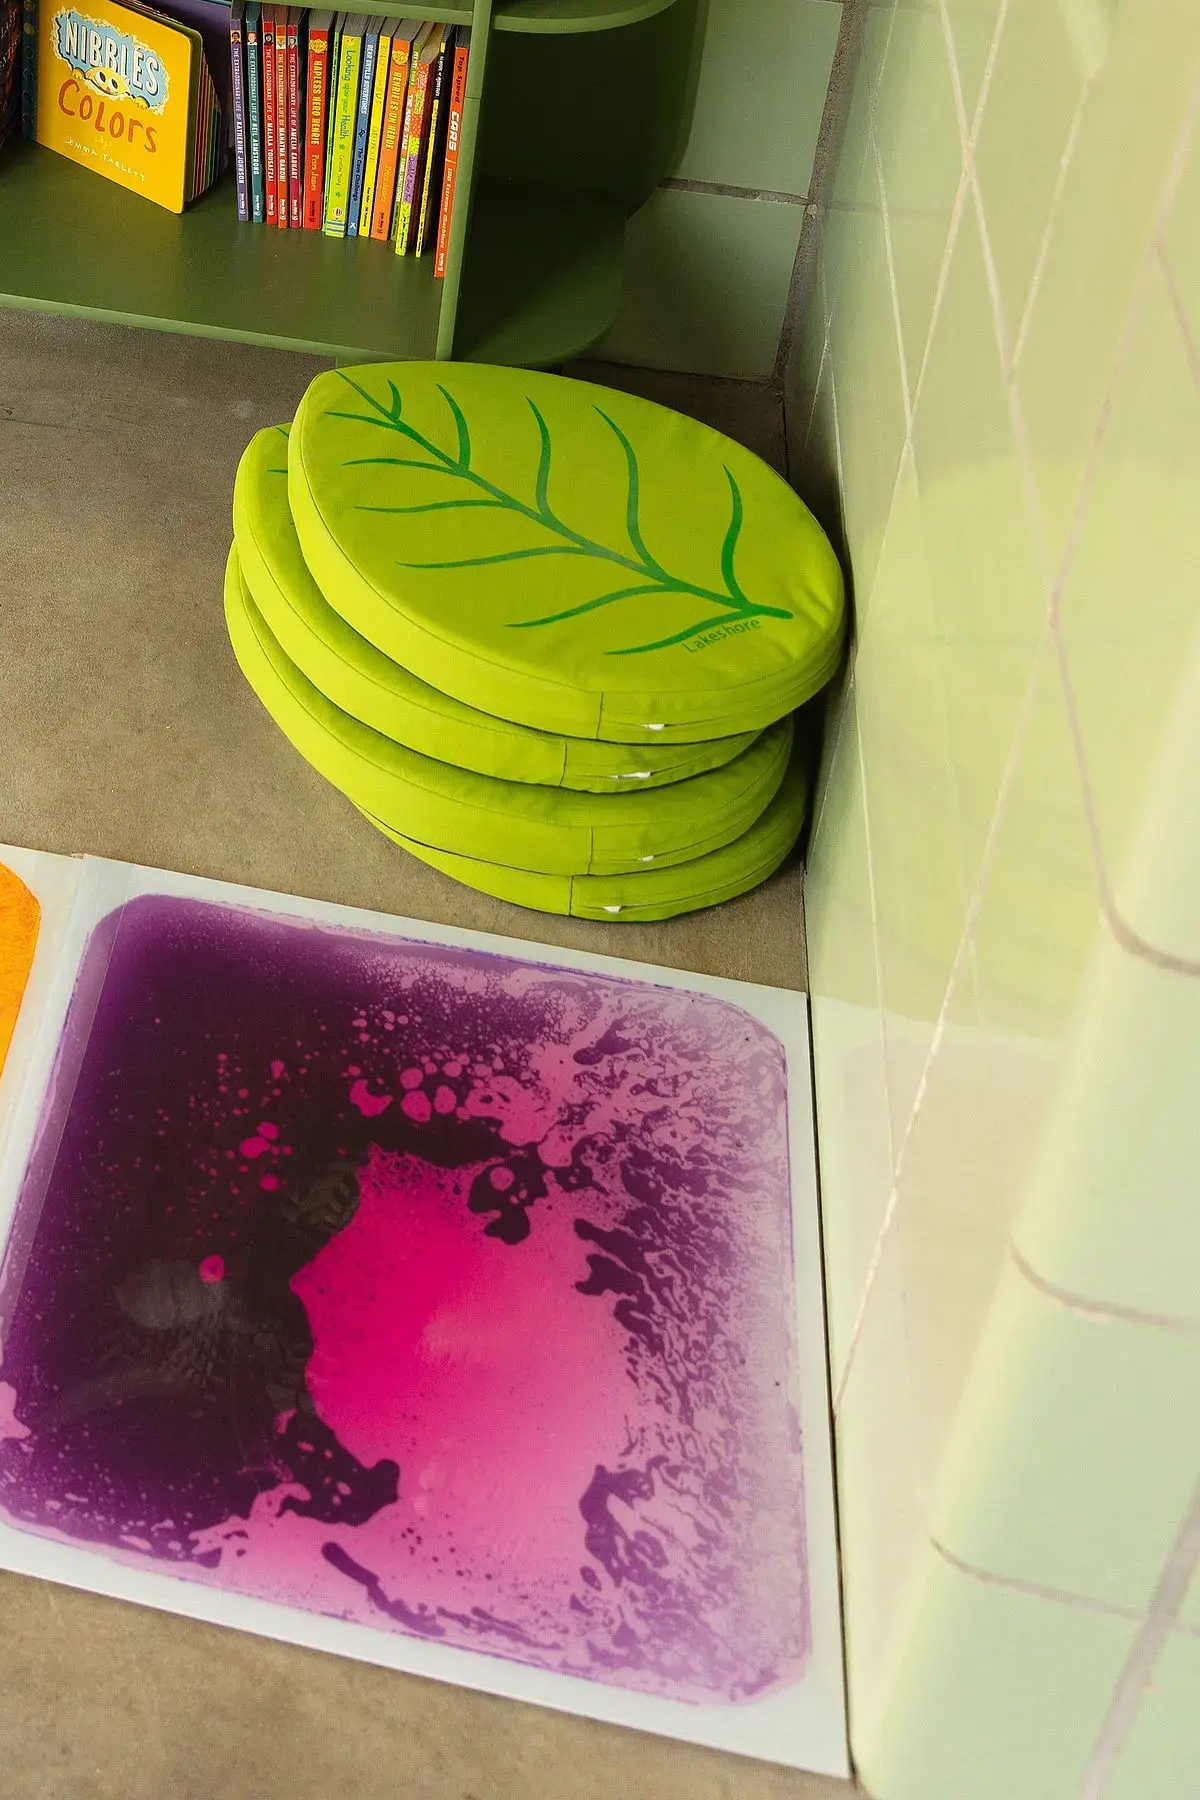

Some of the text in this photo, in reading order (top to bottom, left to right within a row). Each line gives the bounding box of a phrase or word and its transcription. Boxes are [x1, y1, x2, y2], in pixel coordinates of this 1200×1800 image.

[64, 16, 162, 96] NIBBLES
[342, 50, 355, 80] Looking
[390, 71, 401, 98] HENRIE
[310, 60, 322, 145] HAPLESS HERO HENRIE
[389, 100, 398, 110] ES
[338, 114, 350, 139] Health
[387, 112, 397, 124] UN
[447, 110, 459, 151] CARS
[682, 619, 762, 653] Lakeshore
